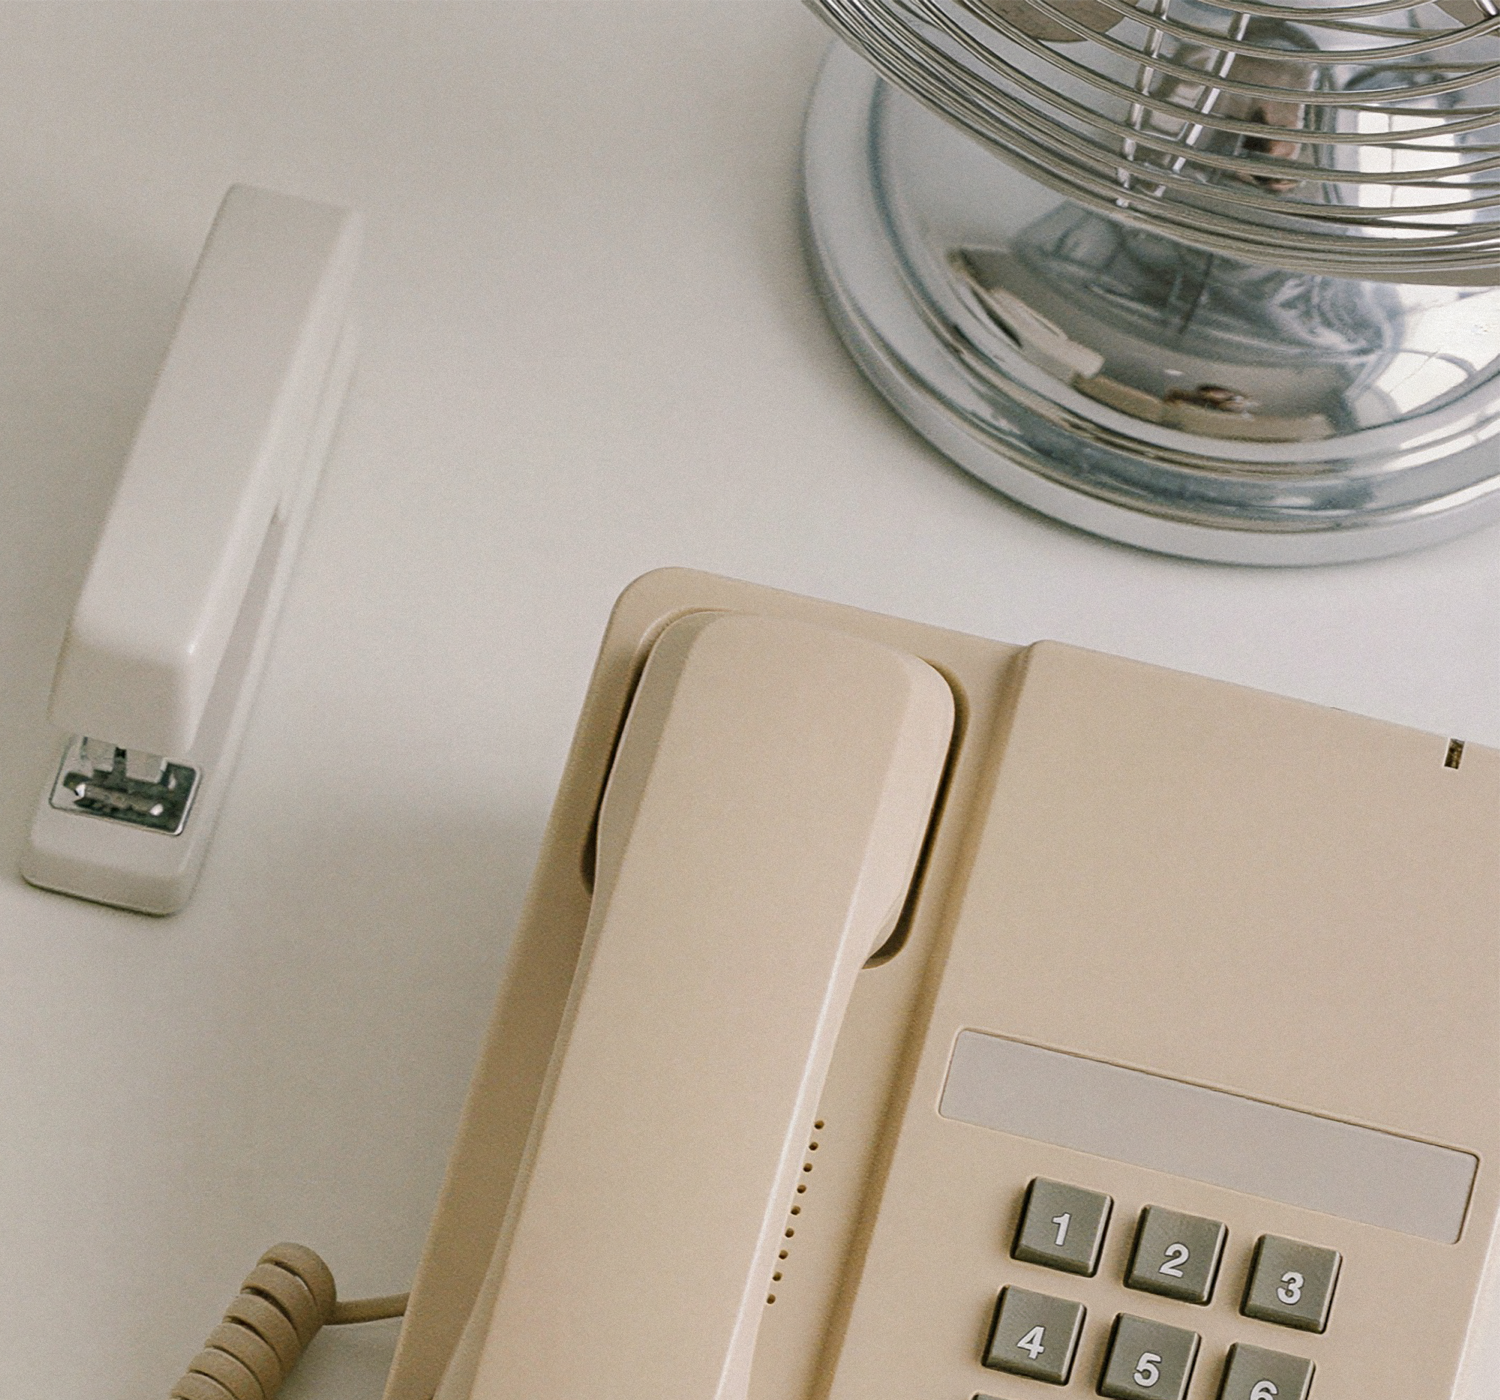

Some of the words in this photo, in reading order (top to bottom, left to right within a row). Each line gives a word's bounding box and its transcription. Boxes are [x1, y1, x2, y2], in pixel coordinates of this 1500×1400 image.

[1052, 1212, 1071, 1247] 1
[1158, 1242, 1190, 1279] 2
[1276, 1270, 1305, 1305] 3
[1015, 1325, 1046, 1360] 4
[1133, 1351, 1162, 1388] 5
